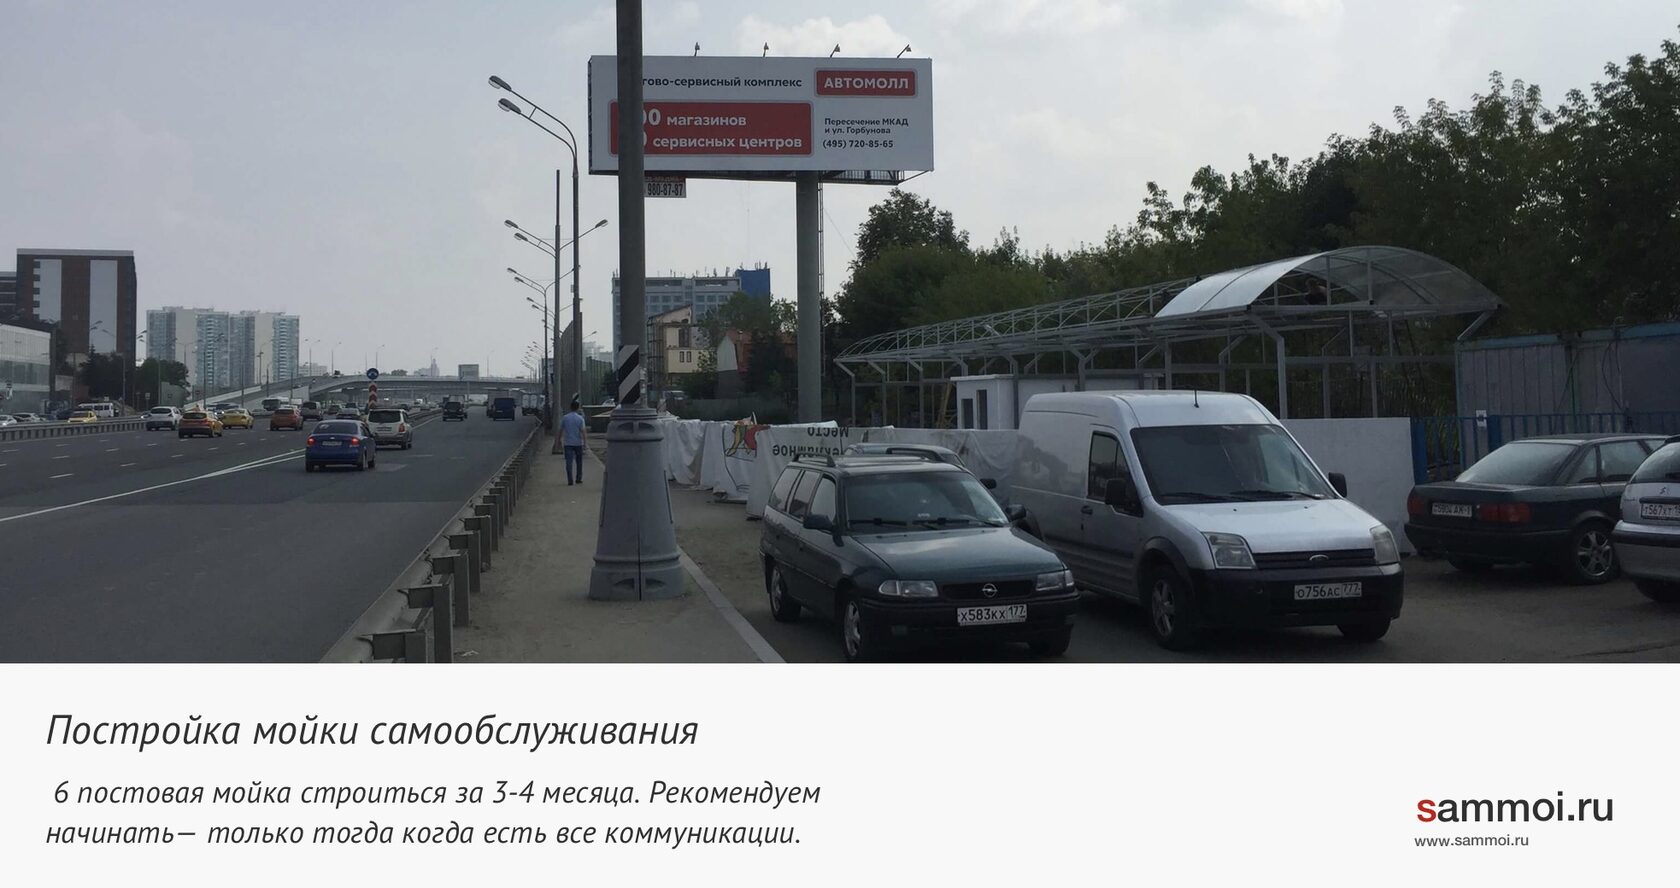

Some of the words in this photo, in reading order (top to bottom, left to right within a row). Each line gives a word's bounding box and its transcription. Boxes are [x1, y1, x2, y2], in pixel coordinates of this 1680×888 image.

[744, 79, 803, 87] комплекс
[824, 77, 909, 89] АВТОМОЛЛ
[667, 115, 747, 126] магазинов
[824, 118, 880, 127] Пересечение
[882, 118, 909, 127] МКАД
[832, 127, 845, 135] ул.
[846, 126, 891, 135] Горбунова
[653, 137, 735, 150] сервисных
[739, 138, 802, 150] центров
[822, 139, 847, 149] (495)
[849, 139, 894, 148] 720-85-65
